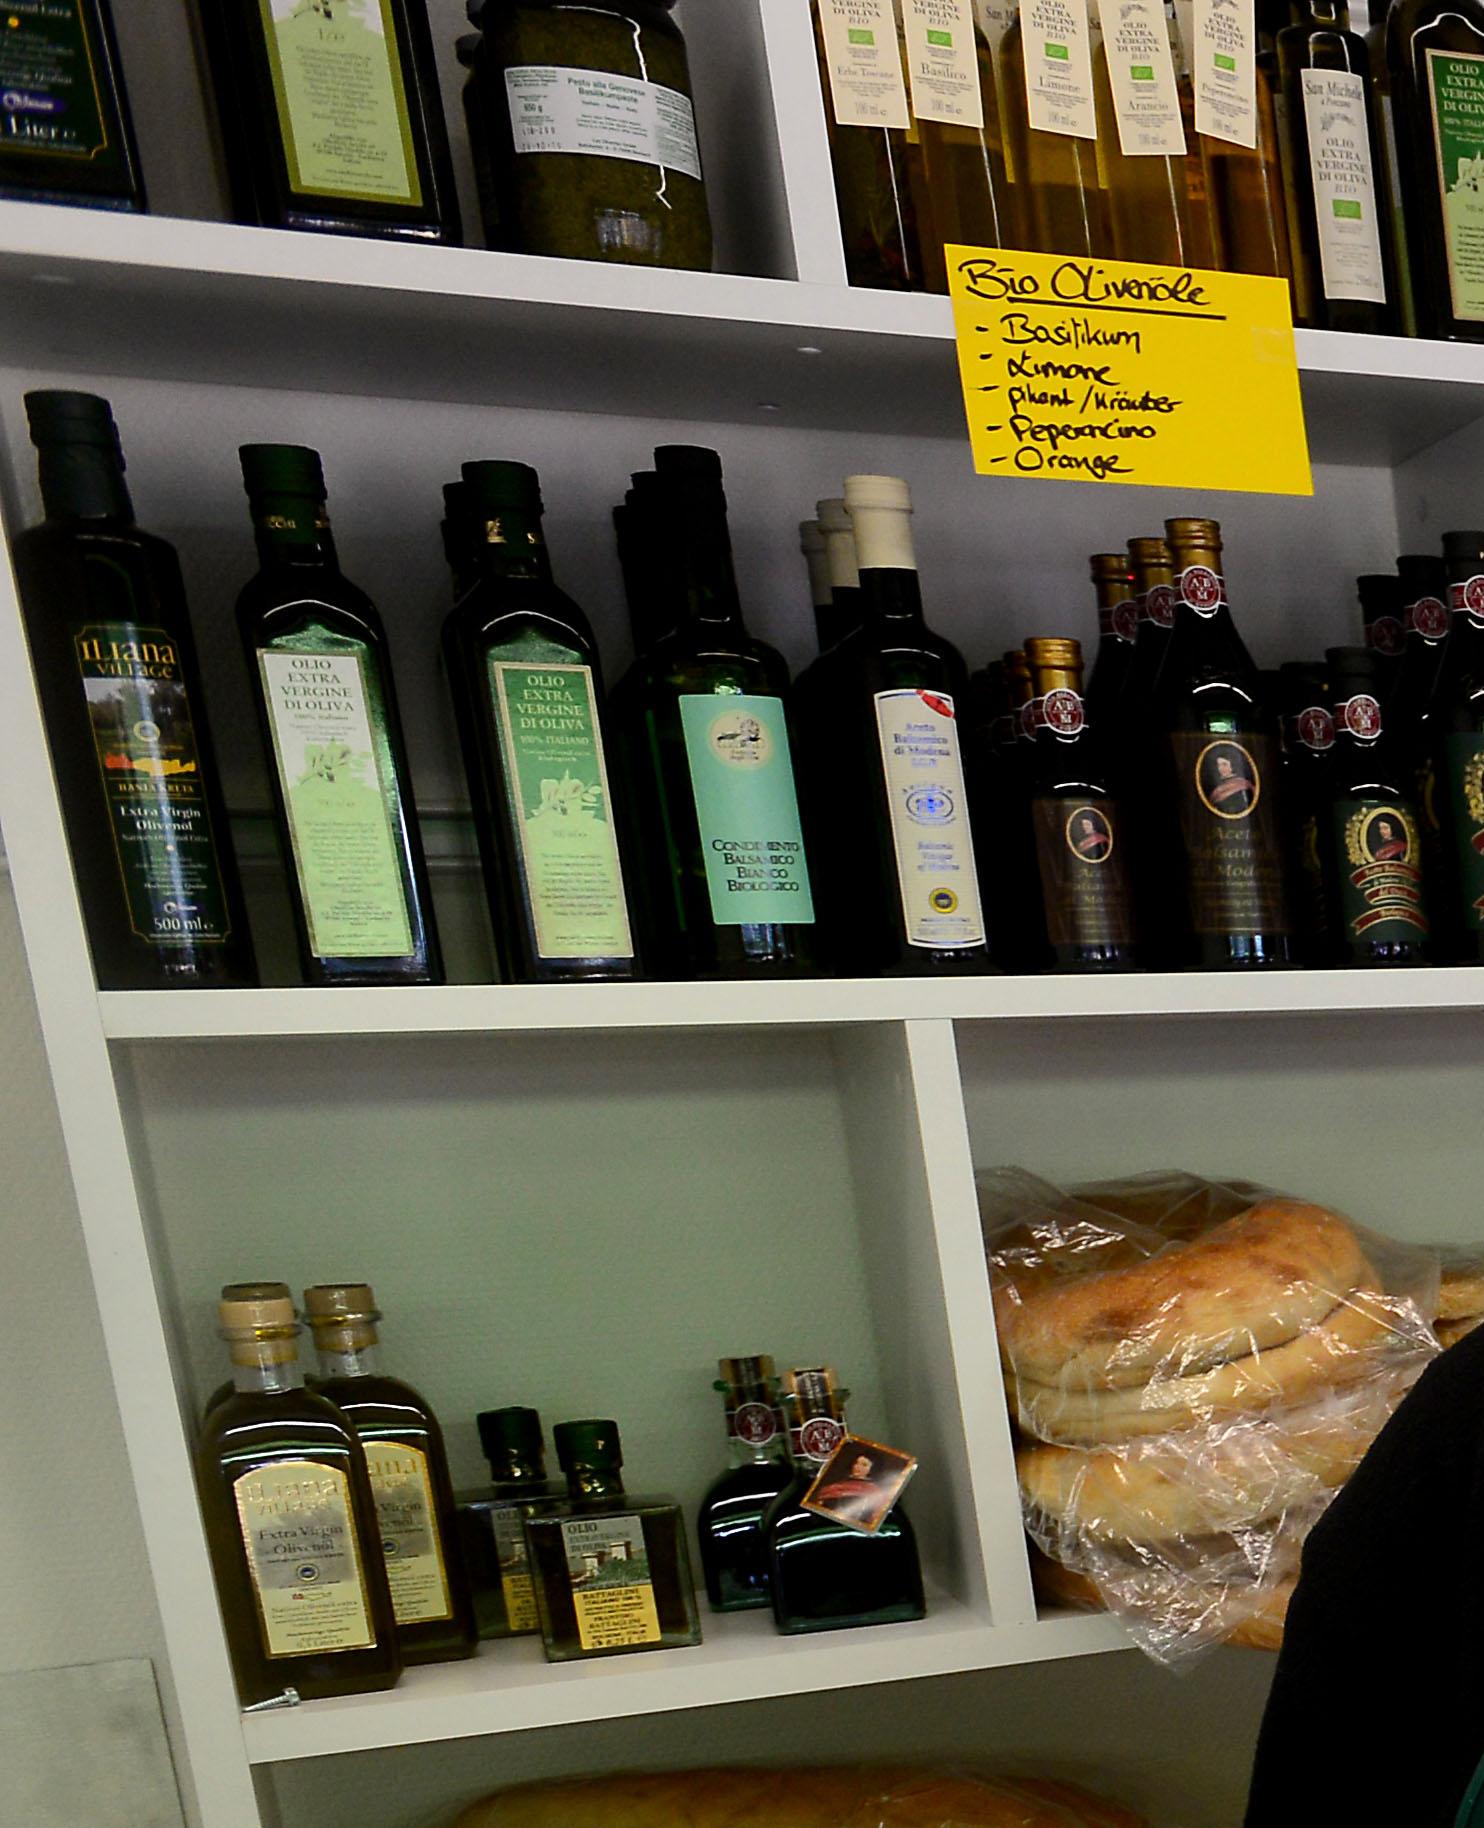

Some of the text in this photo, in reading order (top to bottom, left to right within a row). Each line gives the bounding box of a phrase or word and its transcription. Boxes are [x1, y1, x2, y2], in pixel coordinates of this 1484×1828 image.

[848, 8, 881, 18] OLIVA
[928, 8, 960, 21] OLIVA
[1036, 5, 1071, 18] EXTRA
[1031, 12, 1076, 27] VERGINE
[1122, 22, 1147, 30] OLIO
[1208, 18, 1241, 33] EXTRA
[1032, 19, 1077, 35] DI OLIVA
[1119, 29, 1154, 37] EXTRA
[1114, 37, 1159, 45] VERGINE
[1130, 45, 1160, 53] OLIVA
[920, 62, 967, 81] Basilico
[1450, 62, 1479, 76] OLIO
[1038, 75, 1081, 92] Limone
[1305, 80, 1363, 100] San Michele
[1127, 100, 1169, 112] Arancio
[1443, 100, 1457, 112] DI
[1325, 137, 1354, 149] OLIO
[1321, 148, 1361, 162] EXTRA
[1317, 159, 1368, 174] VERGINE
[1318, 171, 1368, 185] DI OLIVA
[957, 258, 1041, 300] Bio
[1014, 445, 1135, 480] Orange
[291, 659, 332, 671] OLIO
[288, 672, 341, 684] EXTRA
[527, 675, 565, 687] OLIO
[280, 686, 353, 698] VERGINE
[523, 689, 574, 702] EXTRA
[283, 700, 355, 712] DI OLIVA
[516, 703, 585, 717] VERGINE
[520, 717, 585, 731] DI OLIVA
[727, 879, 800, 893] BIOLOGICO
[154, 917, 182, 931] 500
[259, 1525, 344, 1541] Extra Virgin
[567, 1521, 598, 1535] OLIO
[582, 1588, 640, 1600] BATTAGLINI
